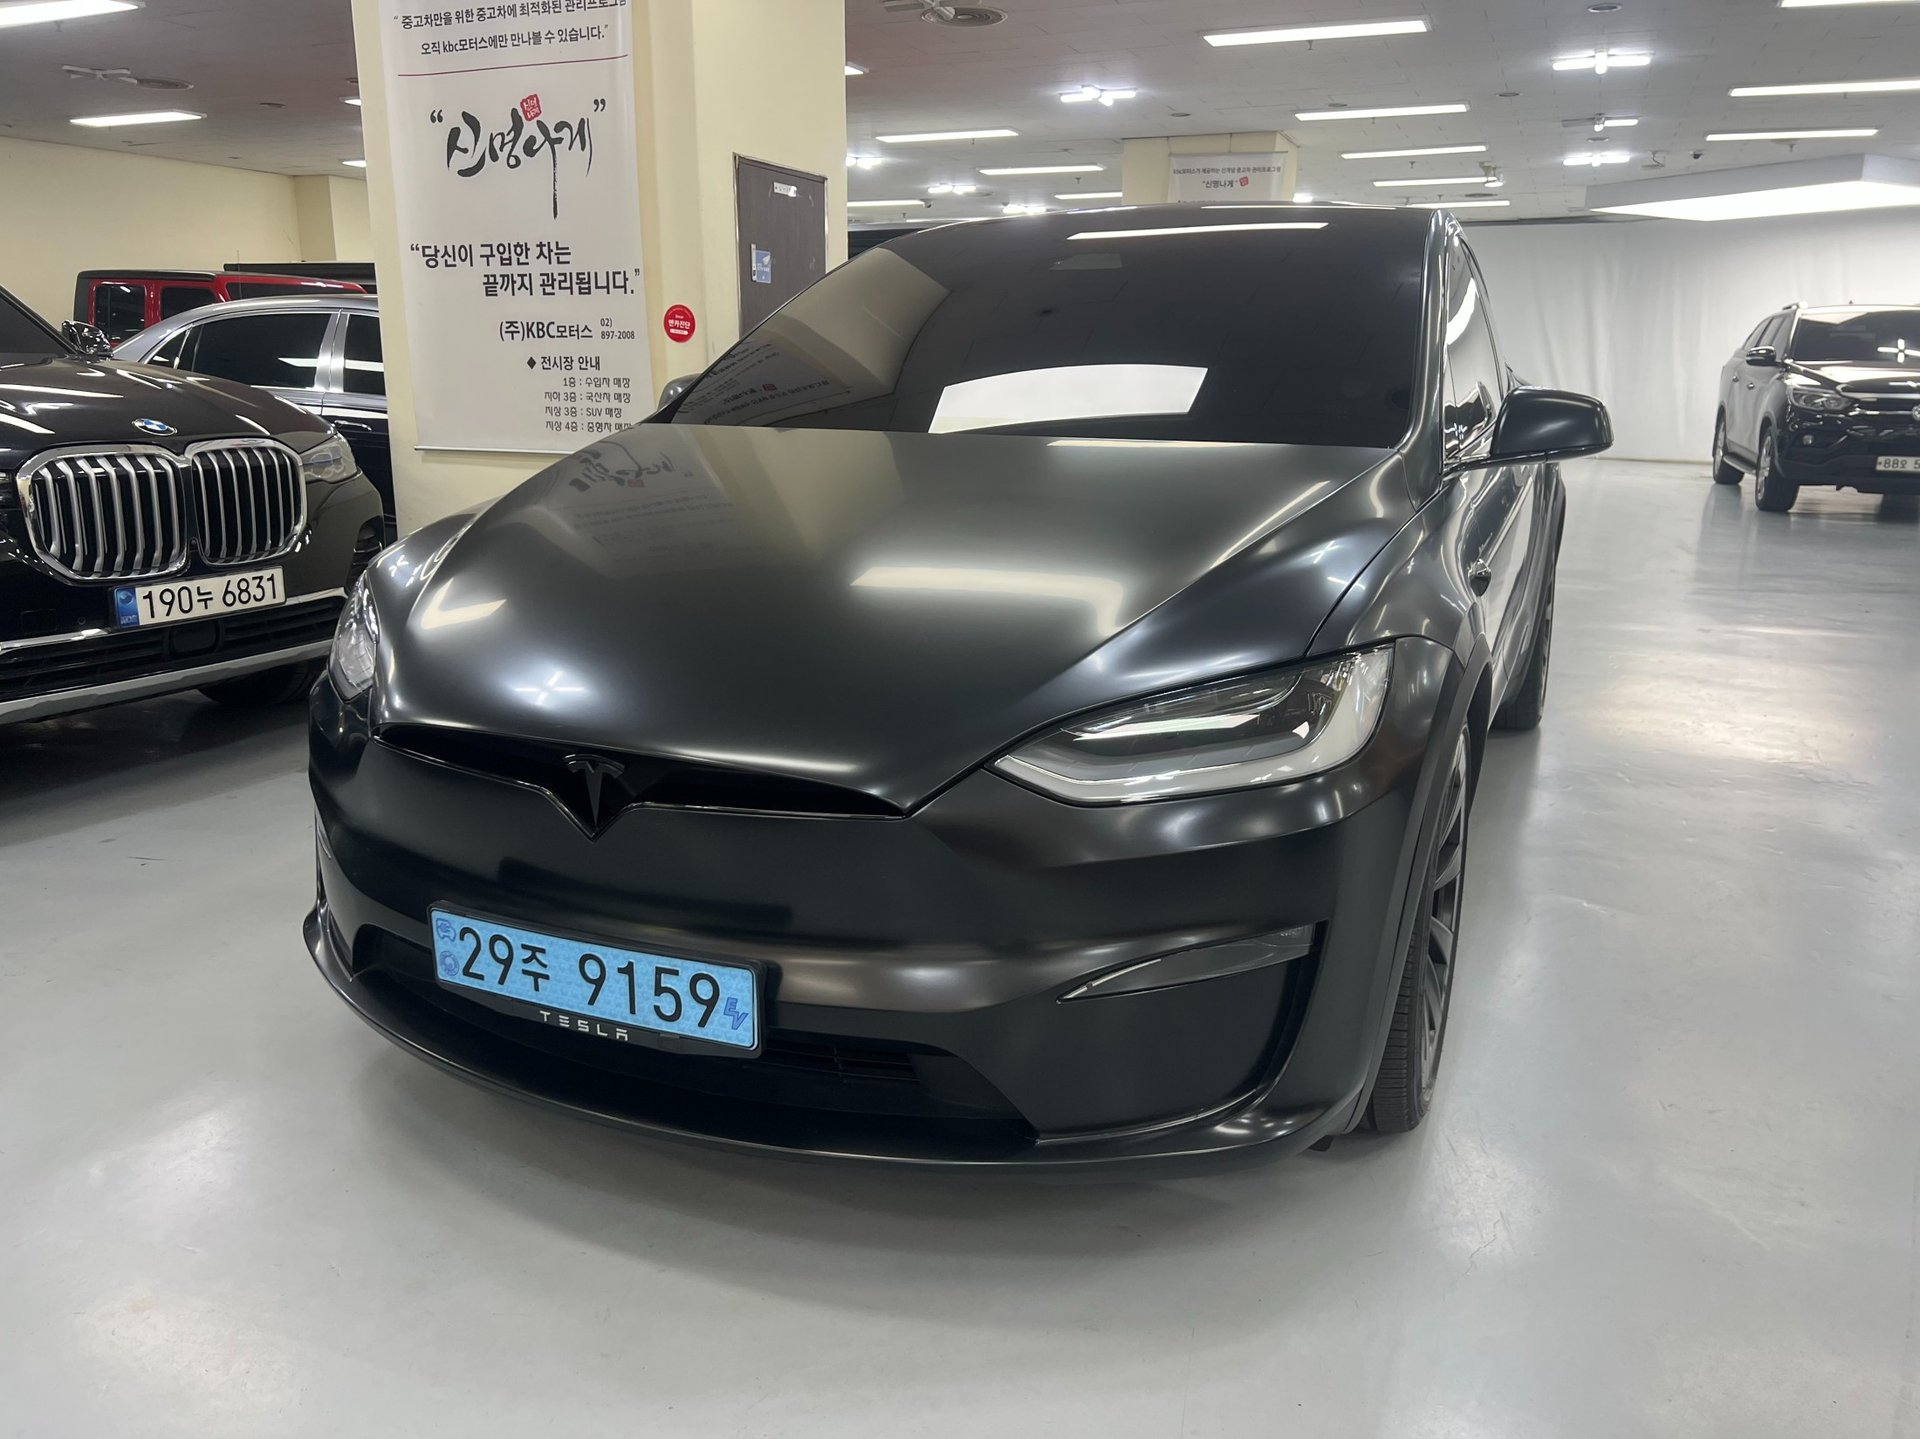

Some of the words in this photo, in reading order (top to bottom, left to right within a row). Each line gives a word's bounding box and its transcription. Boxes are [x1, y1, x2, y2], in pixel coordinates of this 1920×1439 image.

[455, 9, 474, 24] 위한
[476, 3, 517, 22] 중고차에
[519, 0, 562, 17] 최적화된
[421, 41, 440, 54] 오직
[443, 33, 508, 53] kbc모터스에만
[510, 31, 542, 47] 만나볼
[544, 30, 555, 44] 수
[480, 242, 530, 266] 구입한
[536, 241, 572, 265] 차는
[483, 273, 533, 296] 끝까지
[500, 320, 593, 341] (주)KBC모터스
[600, 318, 612, 328] 02)
[600, 330, 635, 340] 897-2008
[541, 356, 574, 371] 전시장
[578, 356, 601, 371] 안내
[586, 407, 602, 417] SUV
[142, 585, 214, 618] 190누
[222, 573, 277, 608] 6831
[459, 926, 550, 993] 29주
[578, 953, 721, 1029] 9159
[539, 1010, 629, 1042] TESLA
[724, 997, 749, 1031] EV
